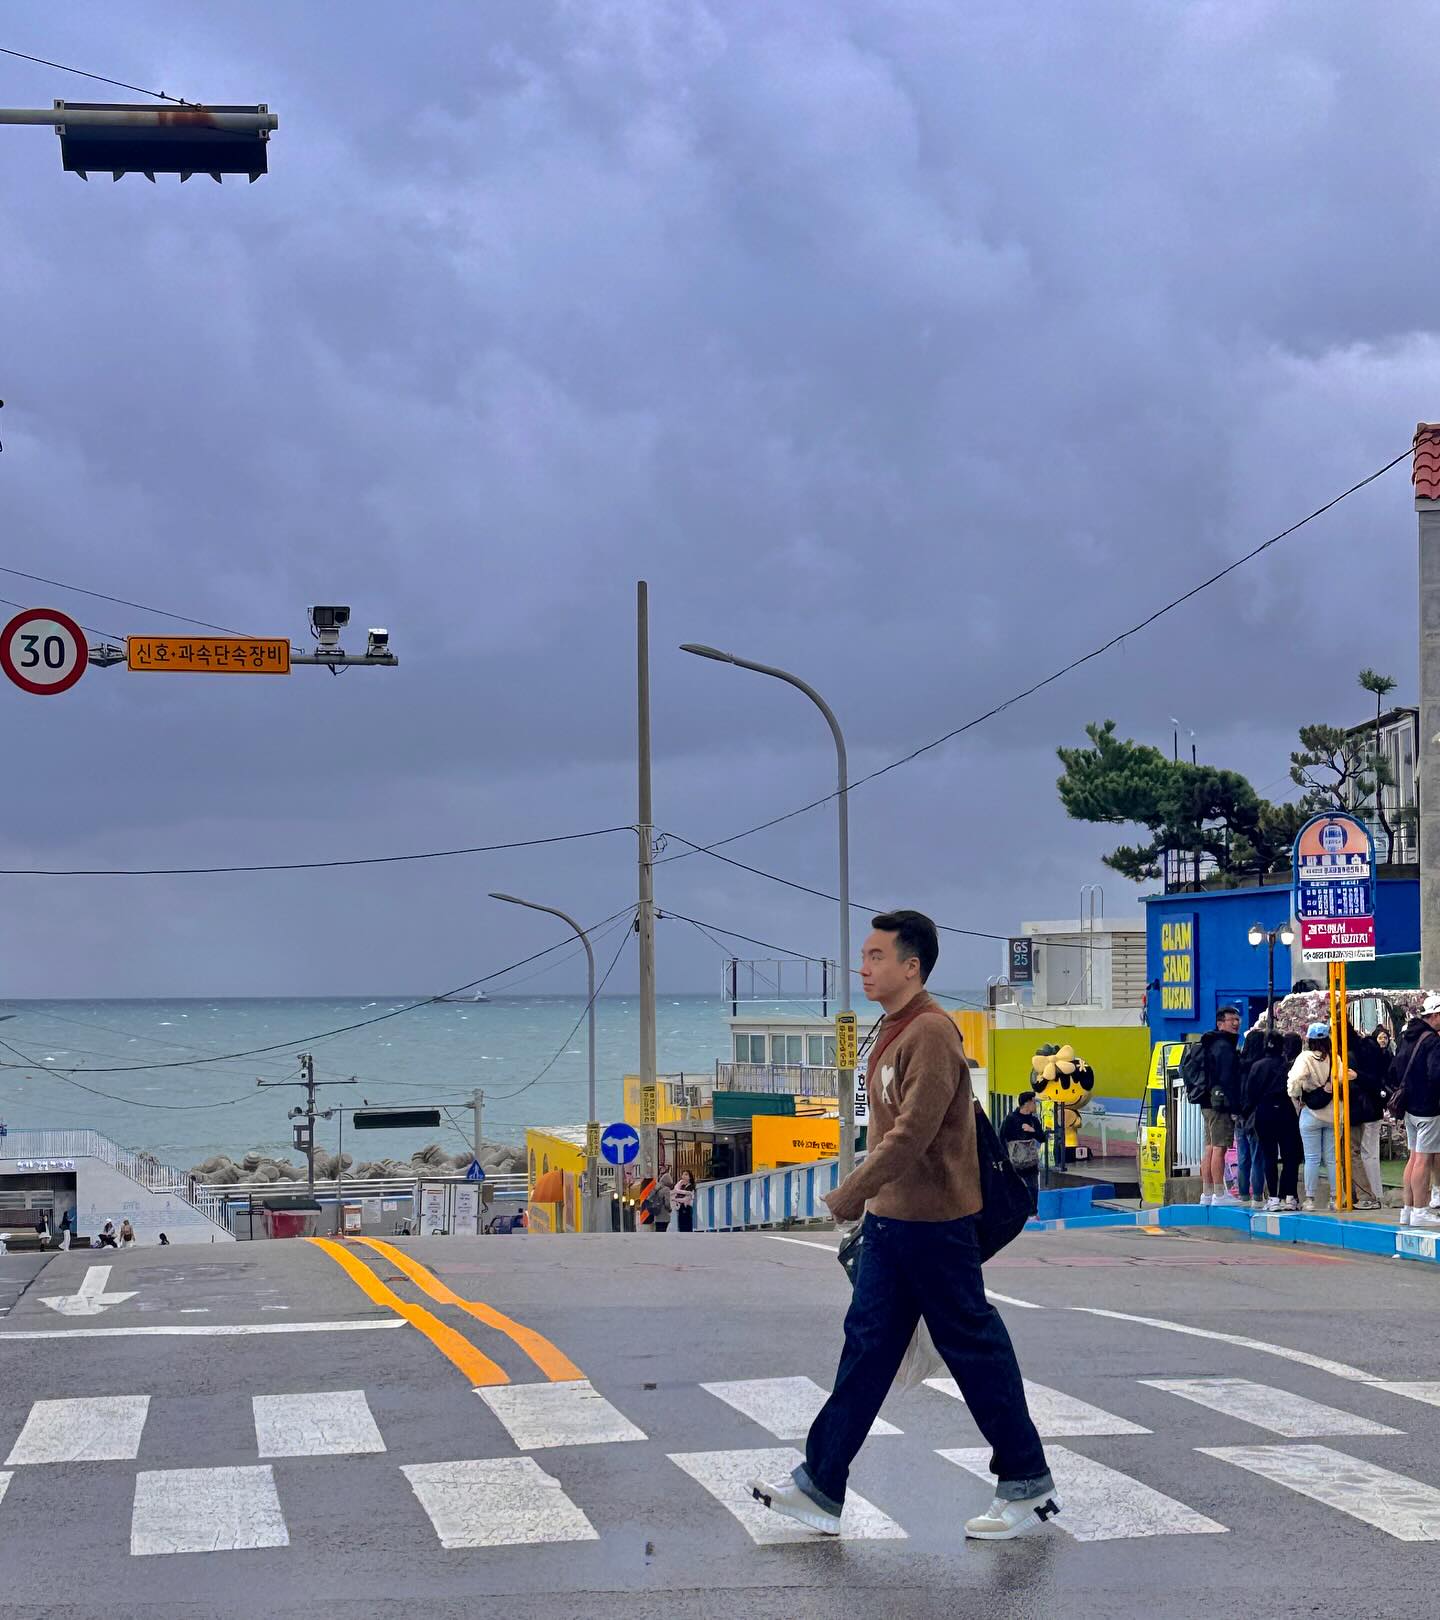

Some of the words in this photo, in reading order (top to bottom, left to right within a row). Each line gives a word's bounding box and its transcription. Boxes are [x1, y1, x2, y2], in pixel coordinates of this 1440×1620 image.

[20, 634, 65, 669] 30
[1013, 941, 1029, 954] GS
[1013, 954, 1029, 966] 25
[1162, 954, 1191, 983] SAND
[1162, 986, 1192, 1010] BUSAN
